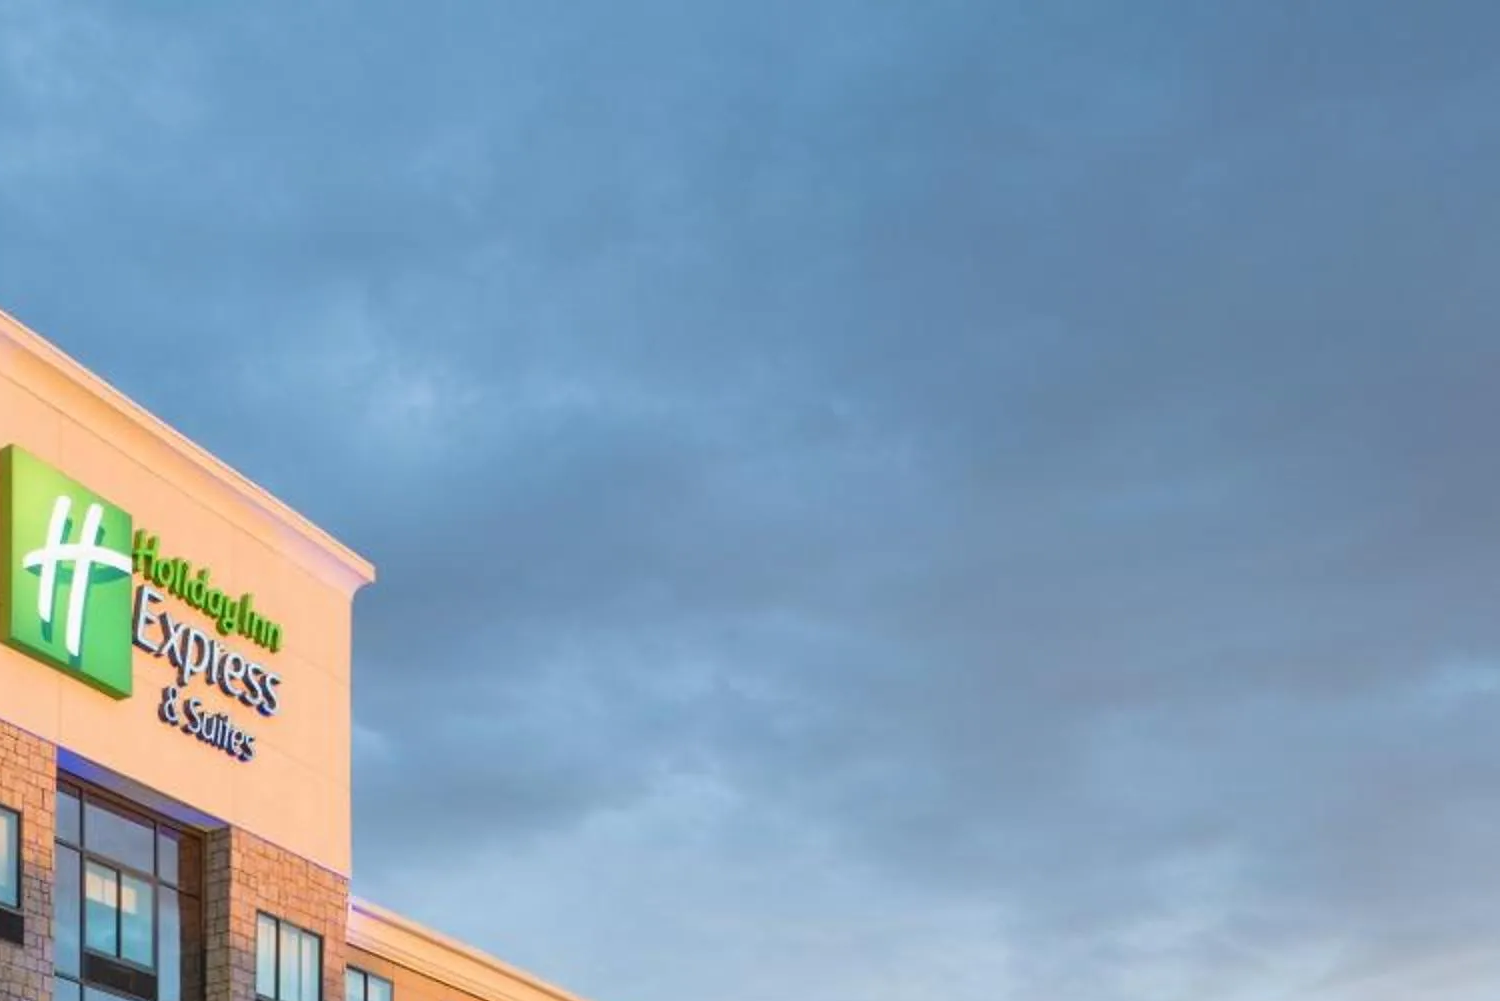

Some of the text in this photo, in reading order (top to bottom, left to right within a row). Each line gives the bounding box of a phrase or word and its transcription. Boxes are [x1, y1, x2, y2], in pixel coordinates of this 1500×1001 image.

[132, 528, 239, 635] Holiday
[132, 584, 281, 717] Express
[158, 686, 255, 762] & Suites
